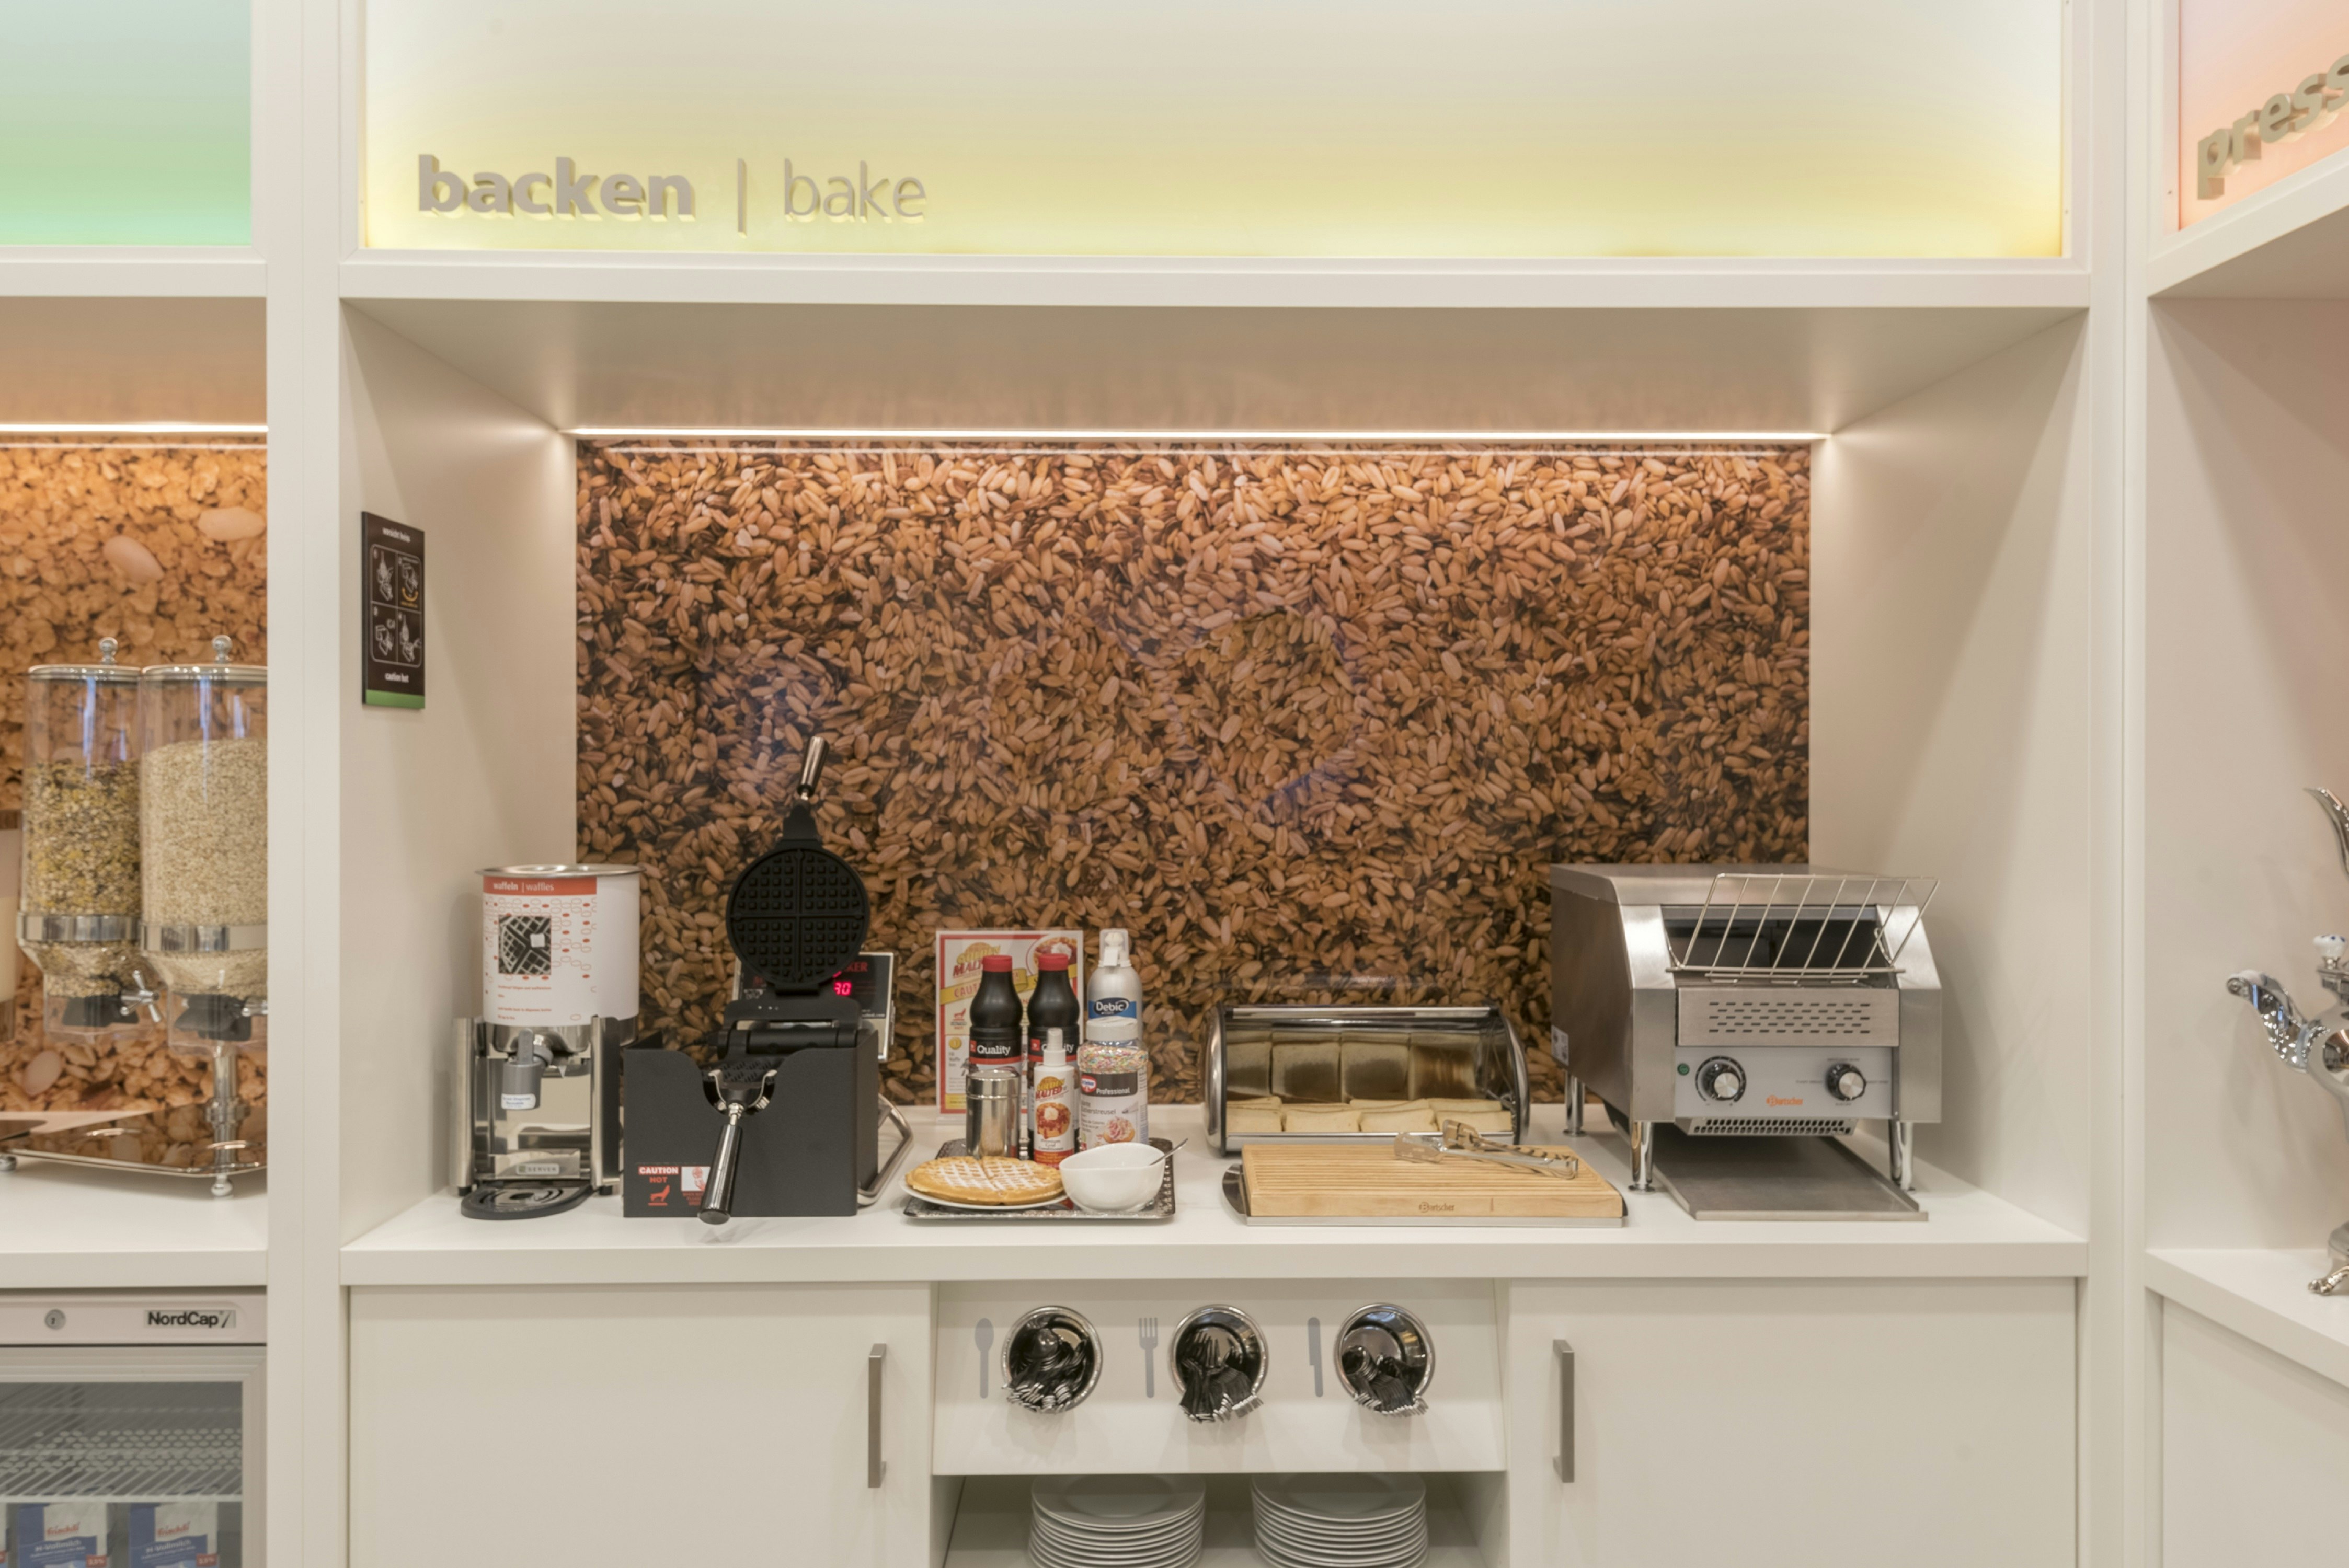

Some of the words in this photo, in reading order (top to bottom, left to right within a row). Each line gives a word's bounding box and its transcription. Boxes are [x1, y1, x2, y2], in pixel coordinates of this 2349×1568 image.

[418, 154, 695, 221] backen
[784, 157, 926, 223] bake
[526, 882, 554, 891] waffles
[954, 983, 978, 997] CAUT
[1096, 1001, 1124, 1011] Debic
[977, 1045, 1010, 1055] Quality
[1041, 1044, 1074, 1053] Qity
[148, 1311, 219, 1328] NordCap
